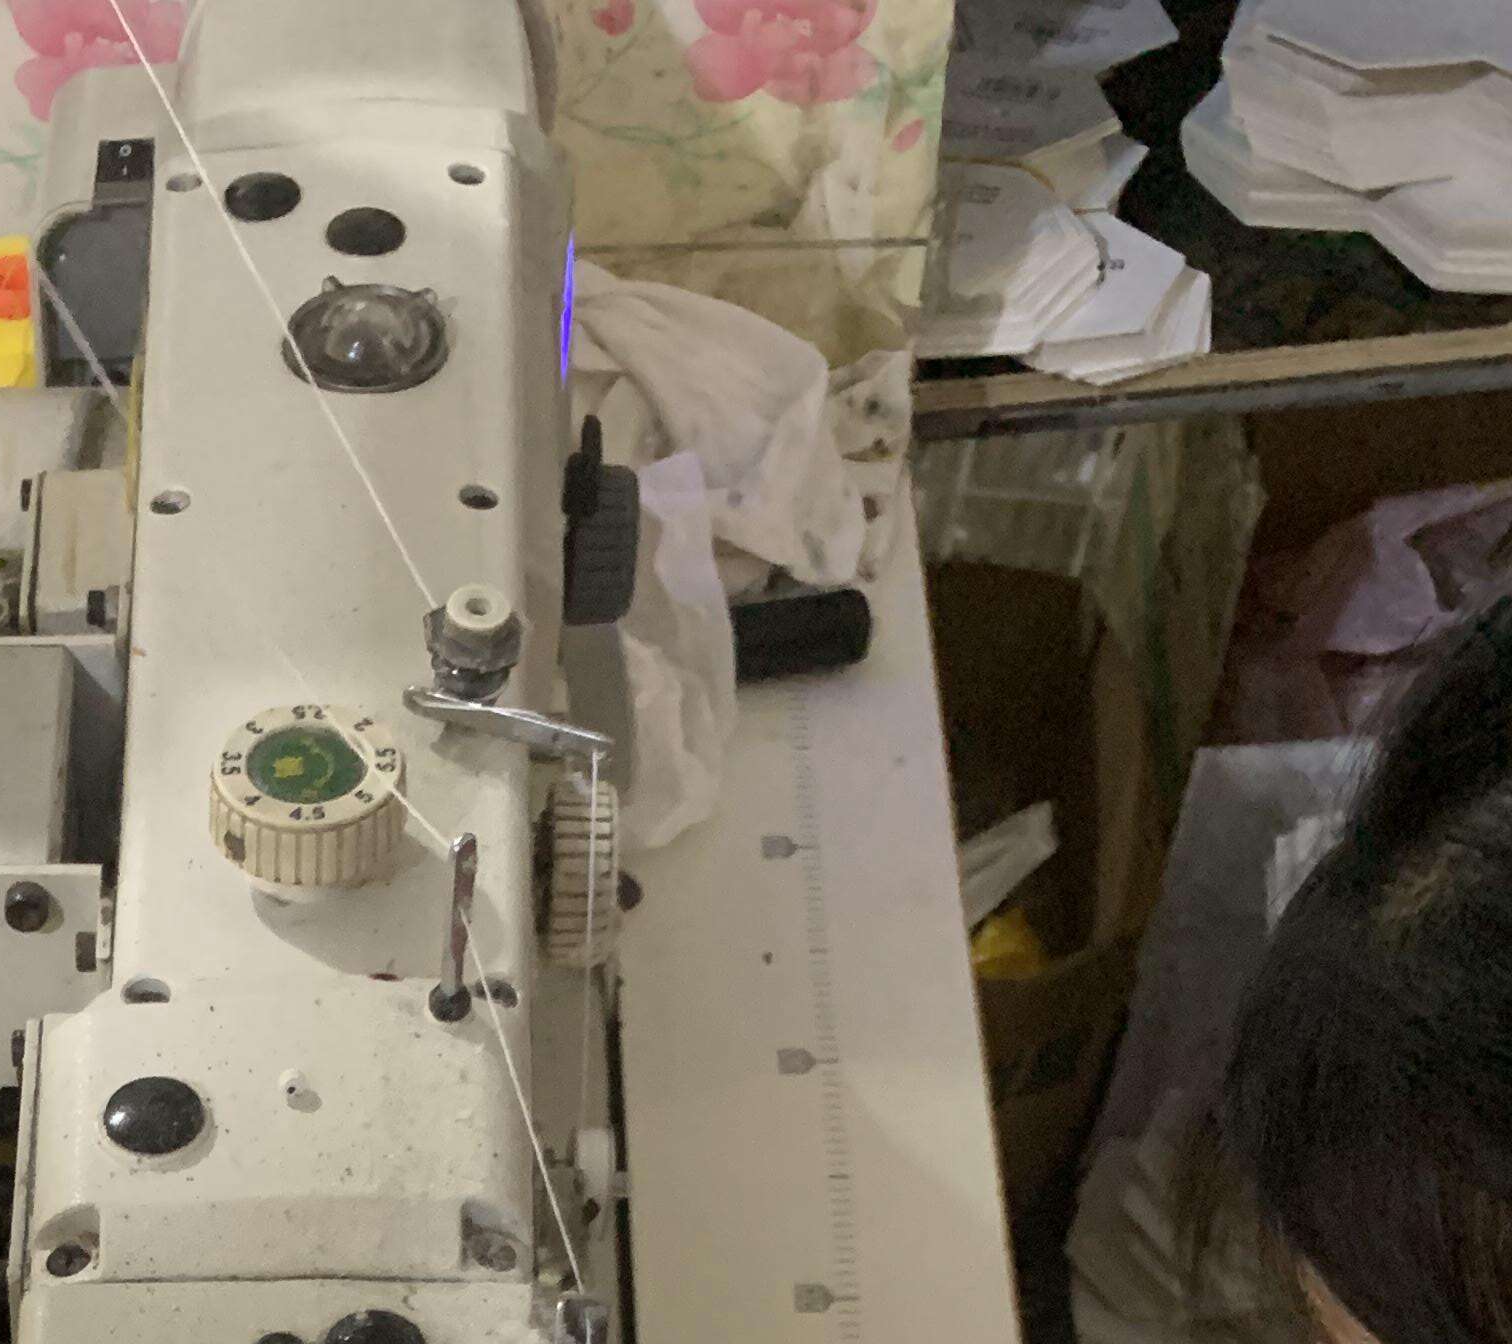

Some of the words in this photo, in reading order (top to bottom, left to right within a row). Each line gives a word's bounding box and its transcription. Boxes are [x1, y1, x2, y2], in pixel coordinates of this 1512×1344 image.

[245, 720, 263, 734] 3
[221, 751, 242, 776] 3.5
[289, 806, 325, 821] 4.5
